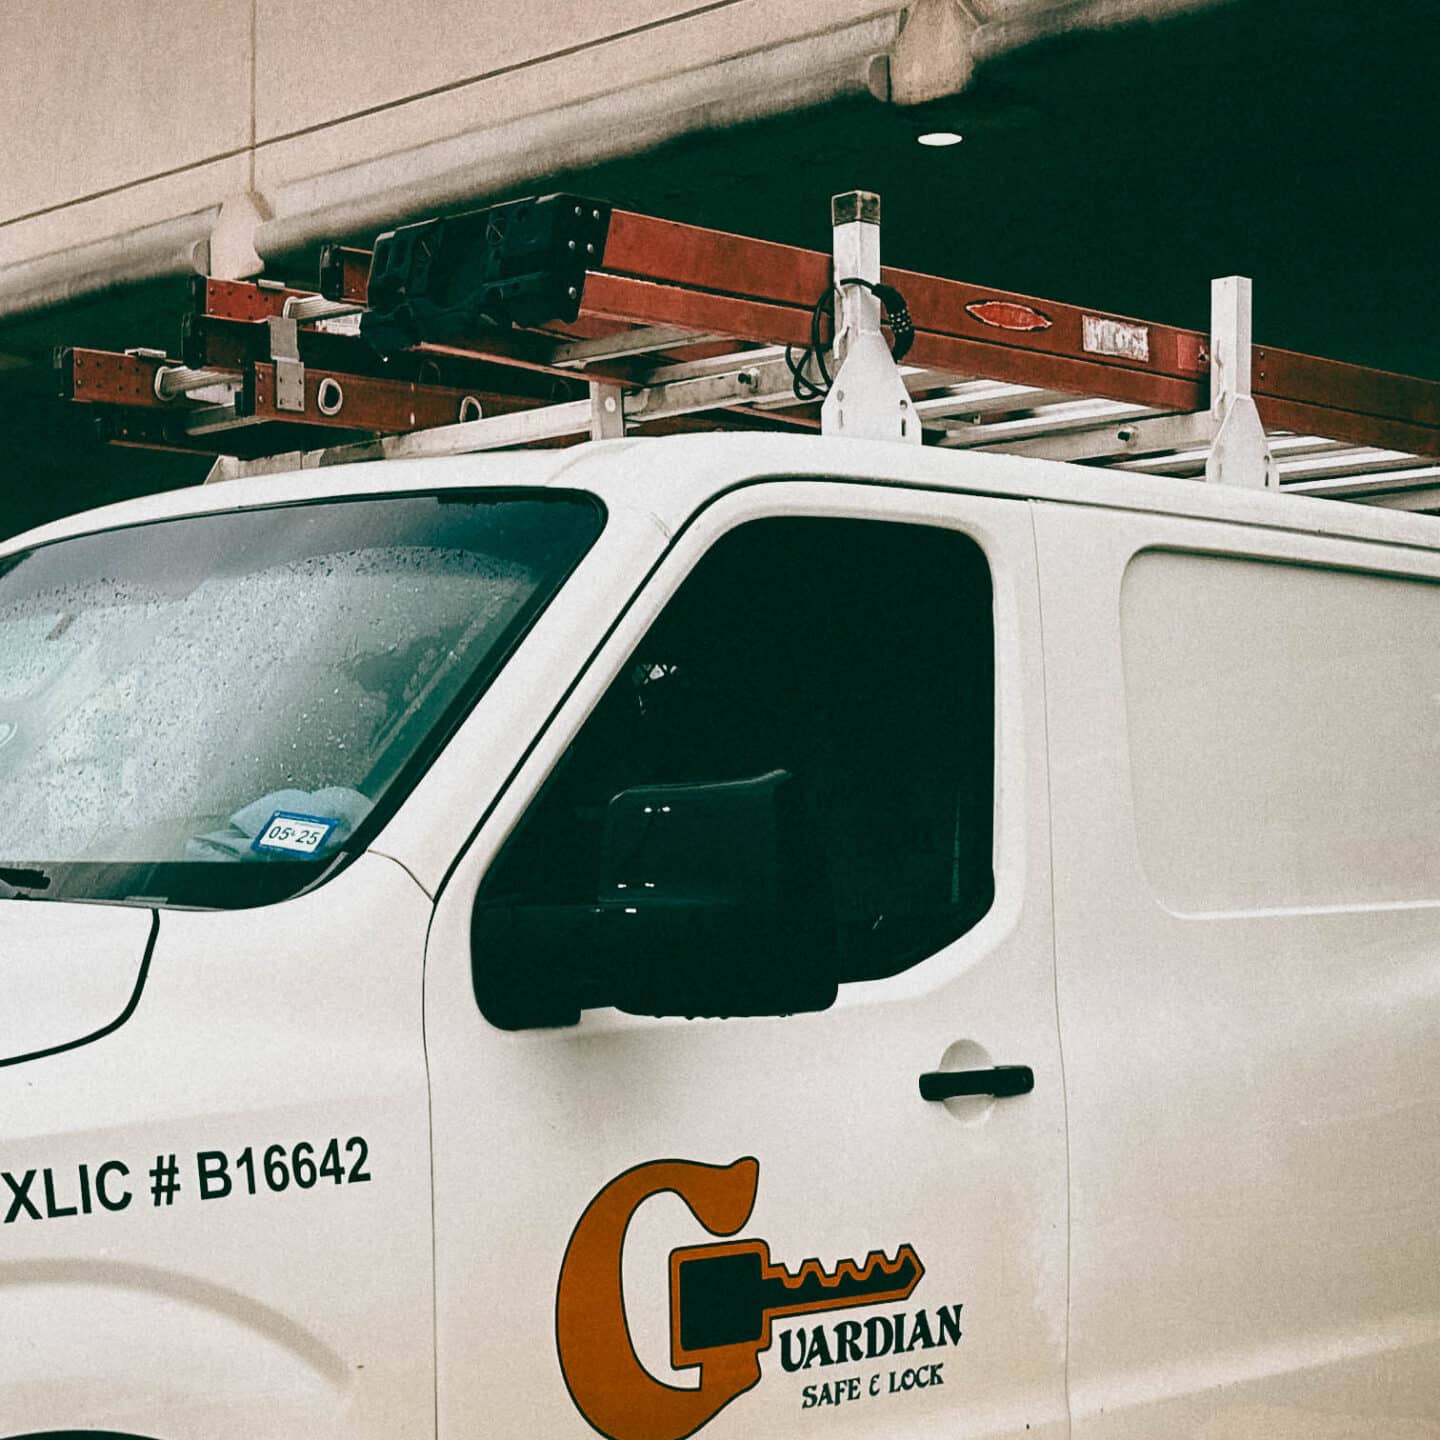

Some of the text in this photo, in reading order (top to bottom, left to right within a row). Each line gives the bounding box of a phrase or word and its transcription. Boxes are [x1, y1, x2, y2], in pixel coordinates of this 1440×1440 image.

[295, 830, 321, 846] 25
[149, 1153, 181, 1207] #
[196, 1136, 372, 1201] B16642
[801, 1376, 862, 1410] SAFE
[888, 1362, 945, 1394] LOCK
